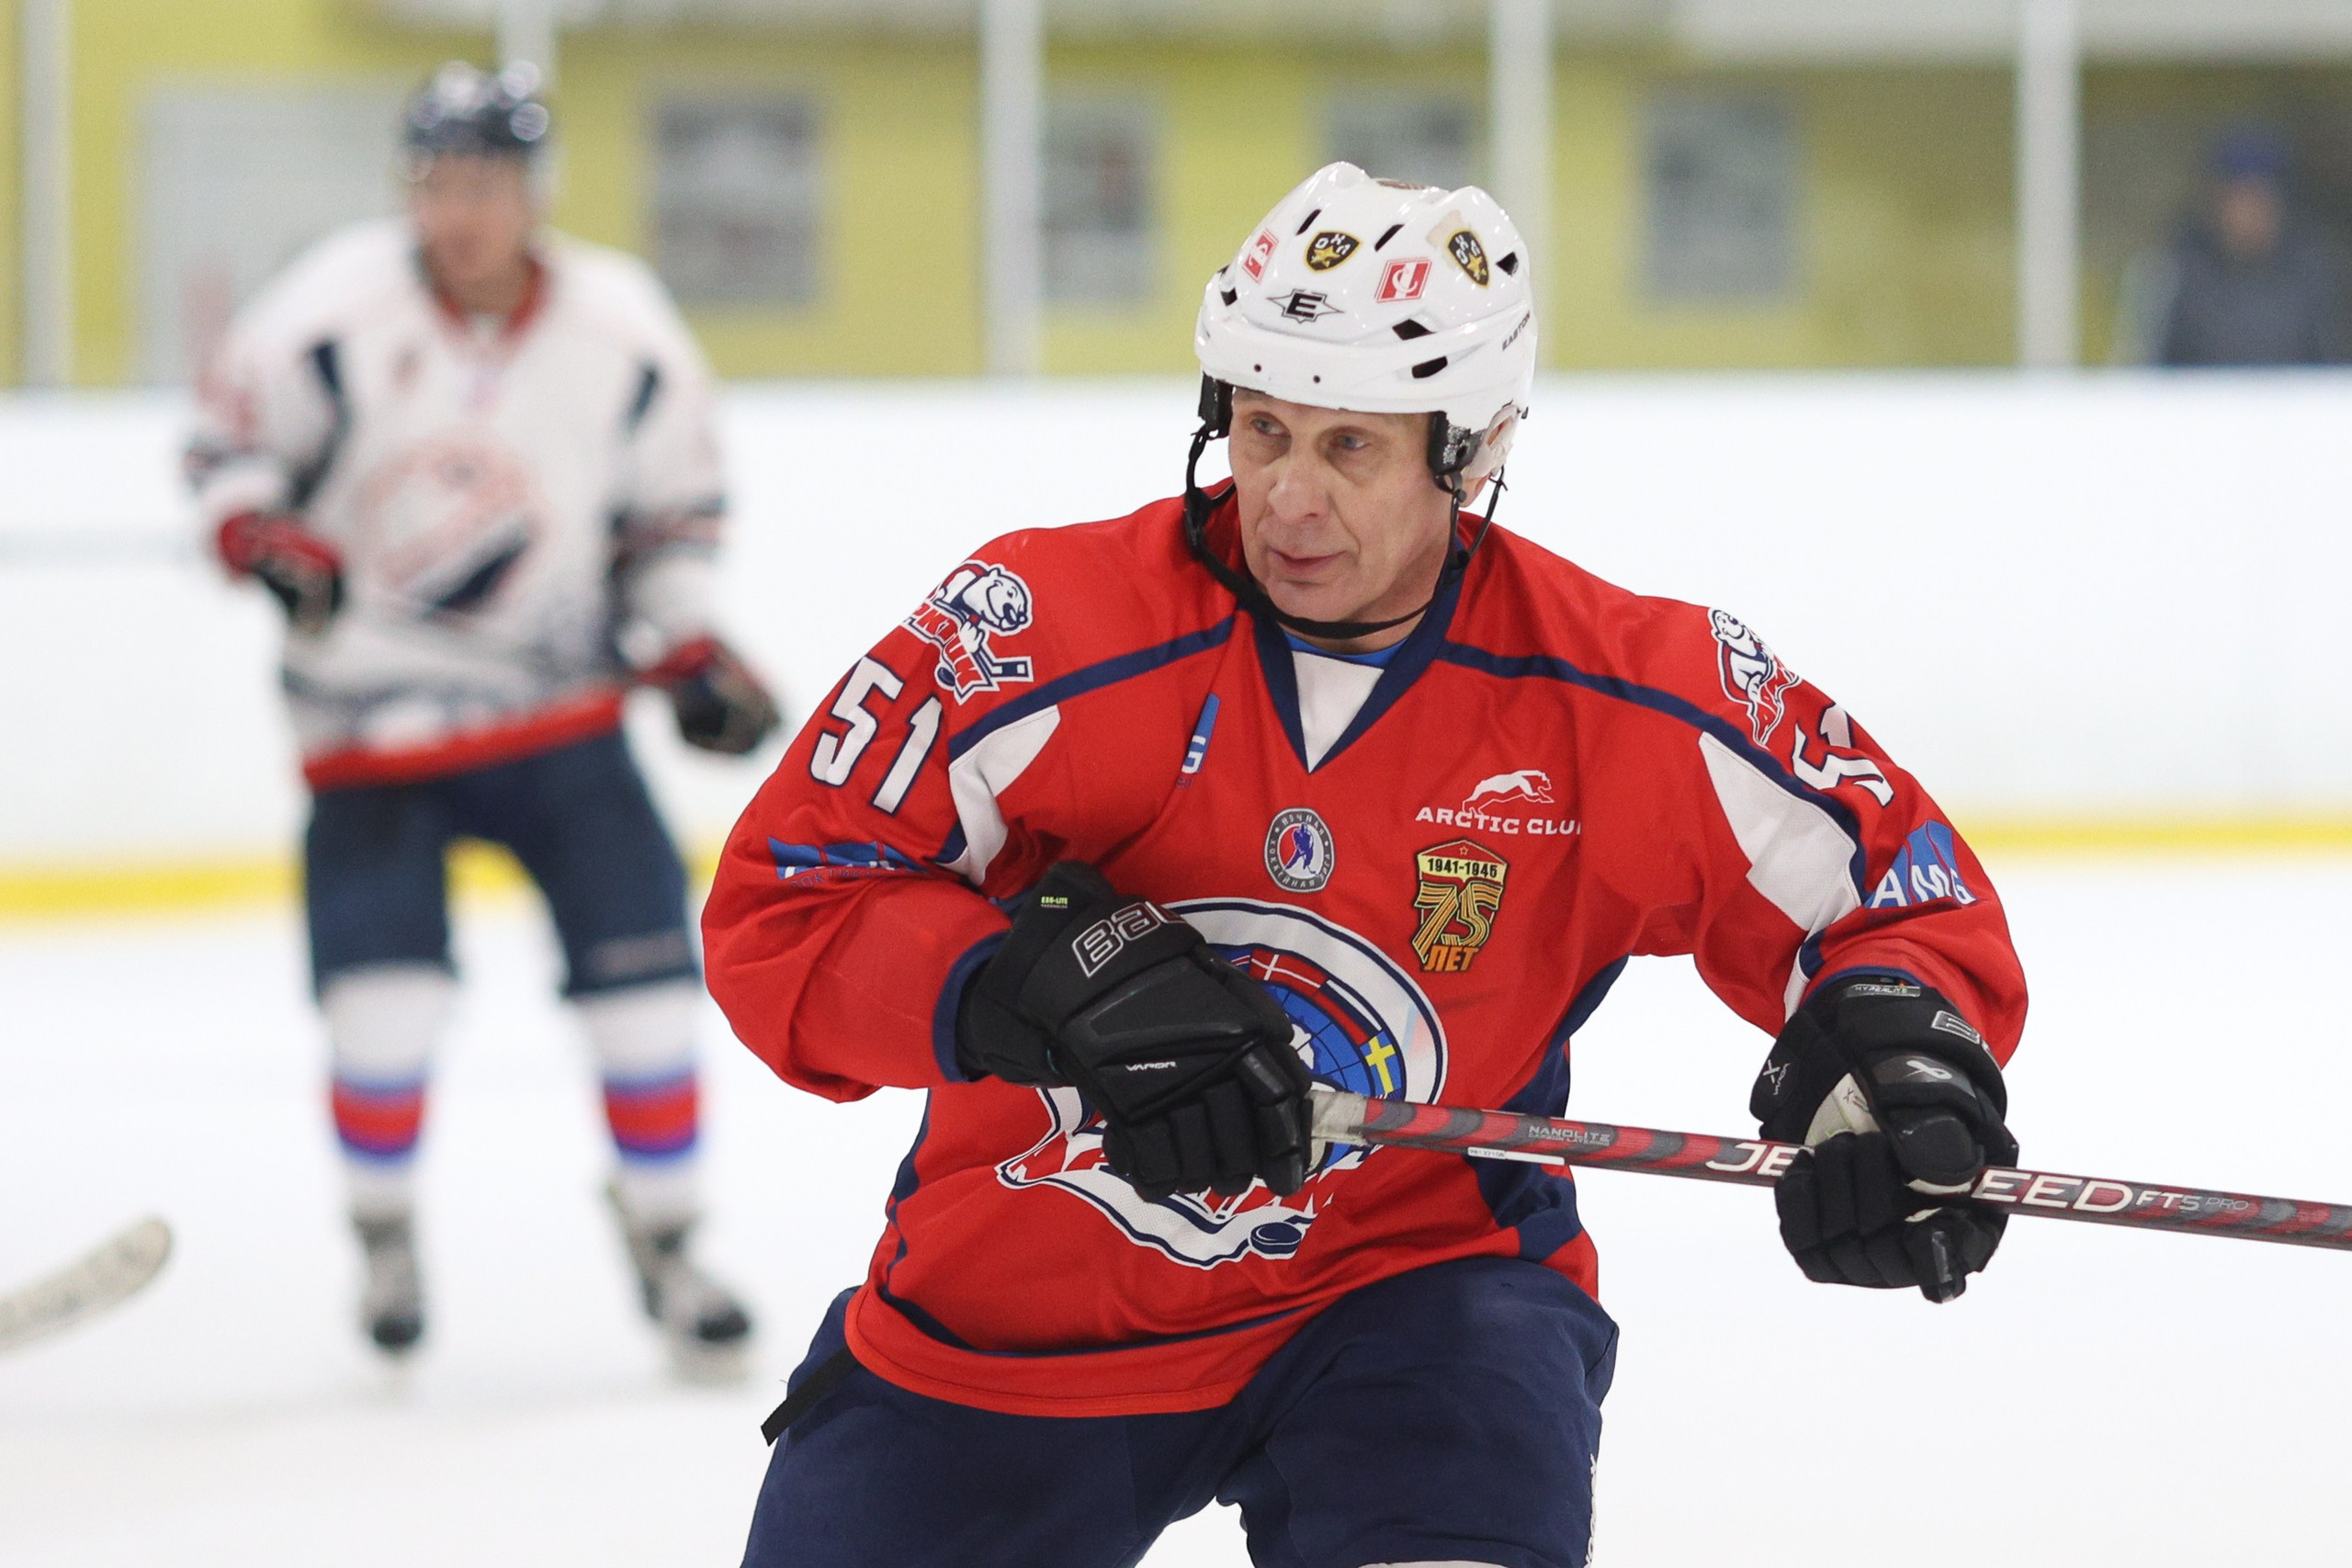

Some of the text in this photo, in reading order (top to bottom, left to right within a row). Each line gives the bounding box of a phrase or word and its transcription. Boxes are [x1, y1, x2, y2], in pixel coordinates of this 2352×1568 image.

[1501, 310, 1531, 351] EASTON
[808, 654, 944, 816] 51
[1415, 807, 1581, 836] ARCTIC CLU
[1412, 879, 1504, 964] 75
[1423, 944, 1480, 972] ЛЕТ
[2205, 1197, 2250, 1211] PRO
